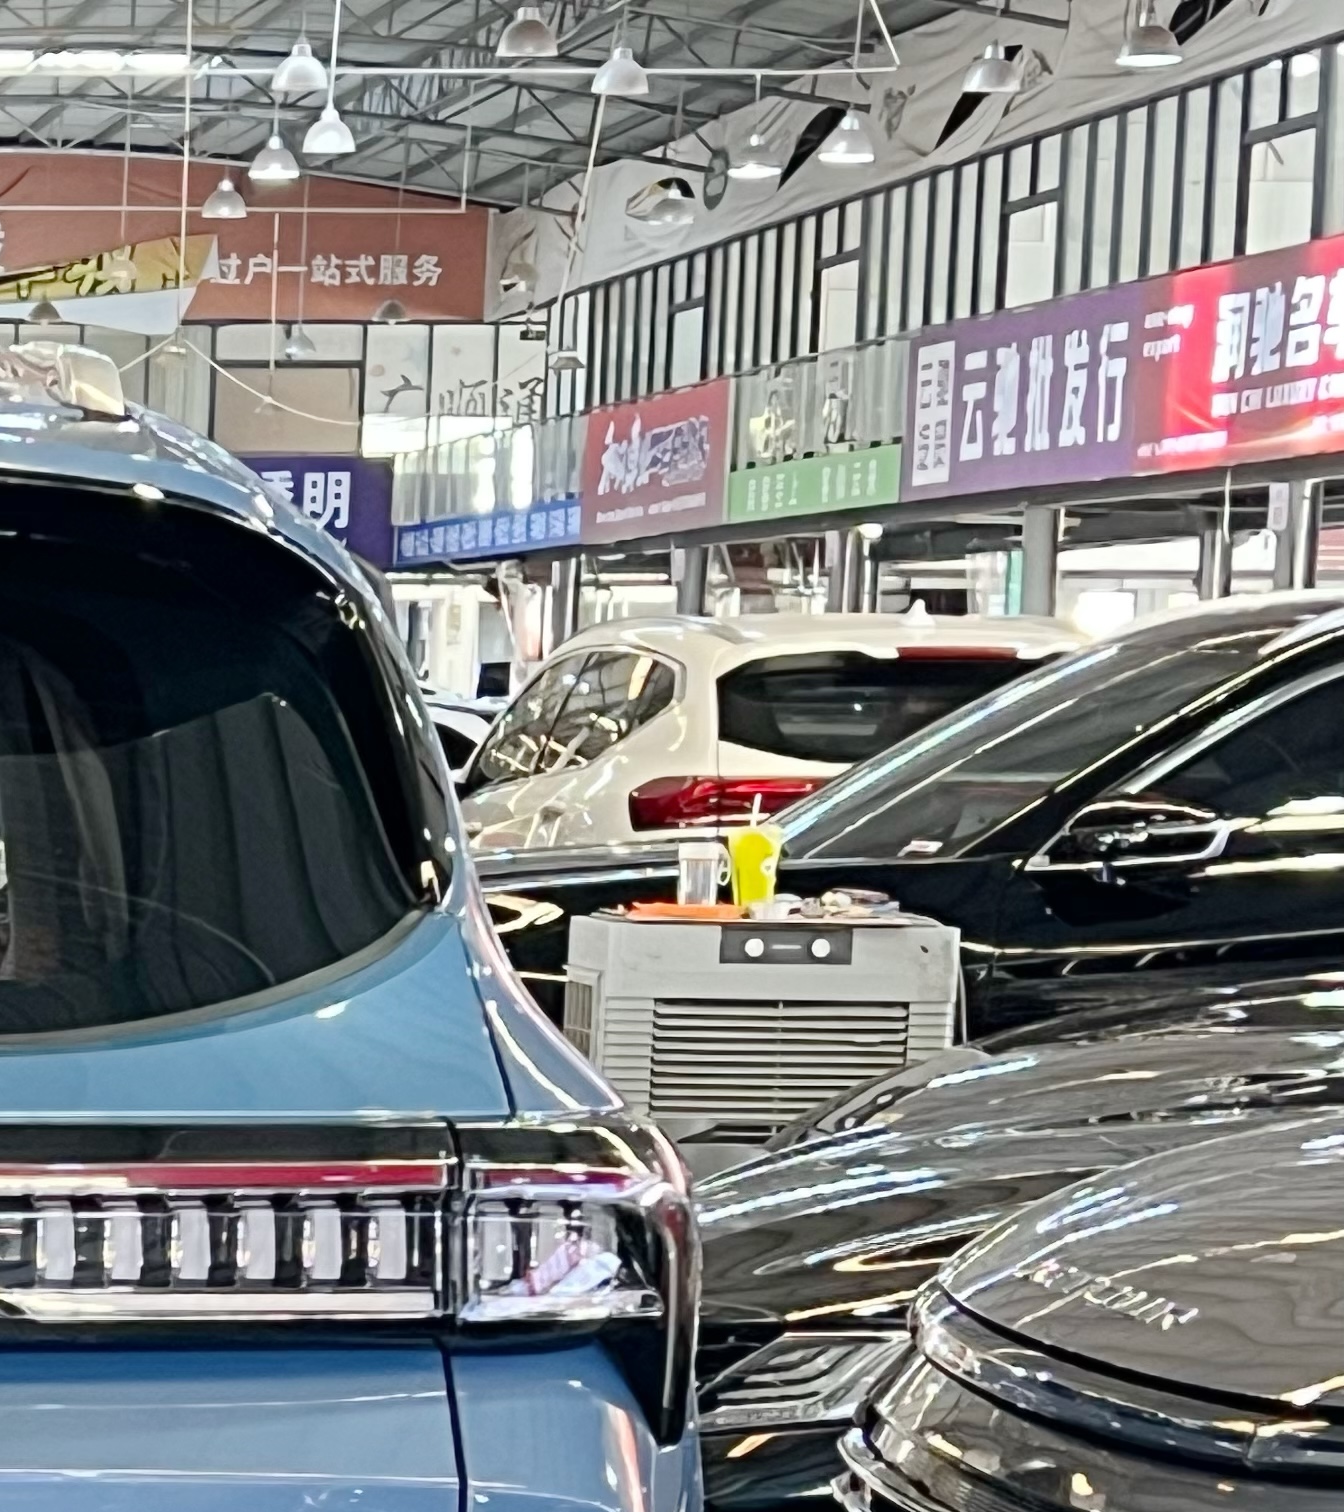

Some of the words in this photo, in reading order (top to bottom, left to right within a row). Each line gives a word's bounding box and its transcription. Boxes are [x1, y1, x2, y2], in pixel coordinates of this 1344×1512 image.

[213, 252, 443, 287] 过户一站式服务
